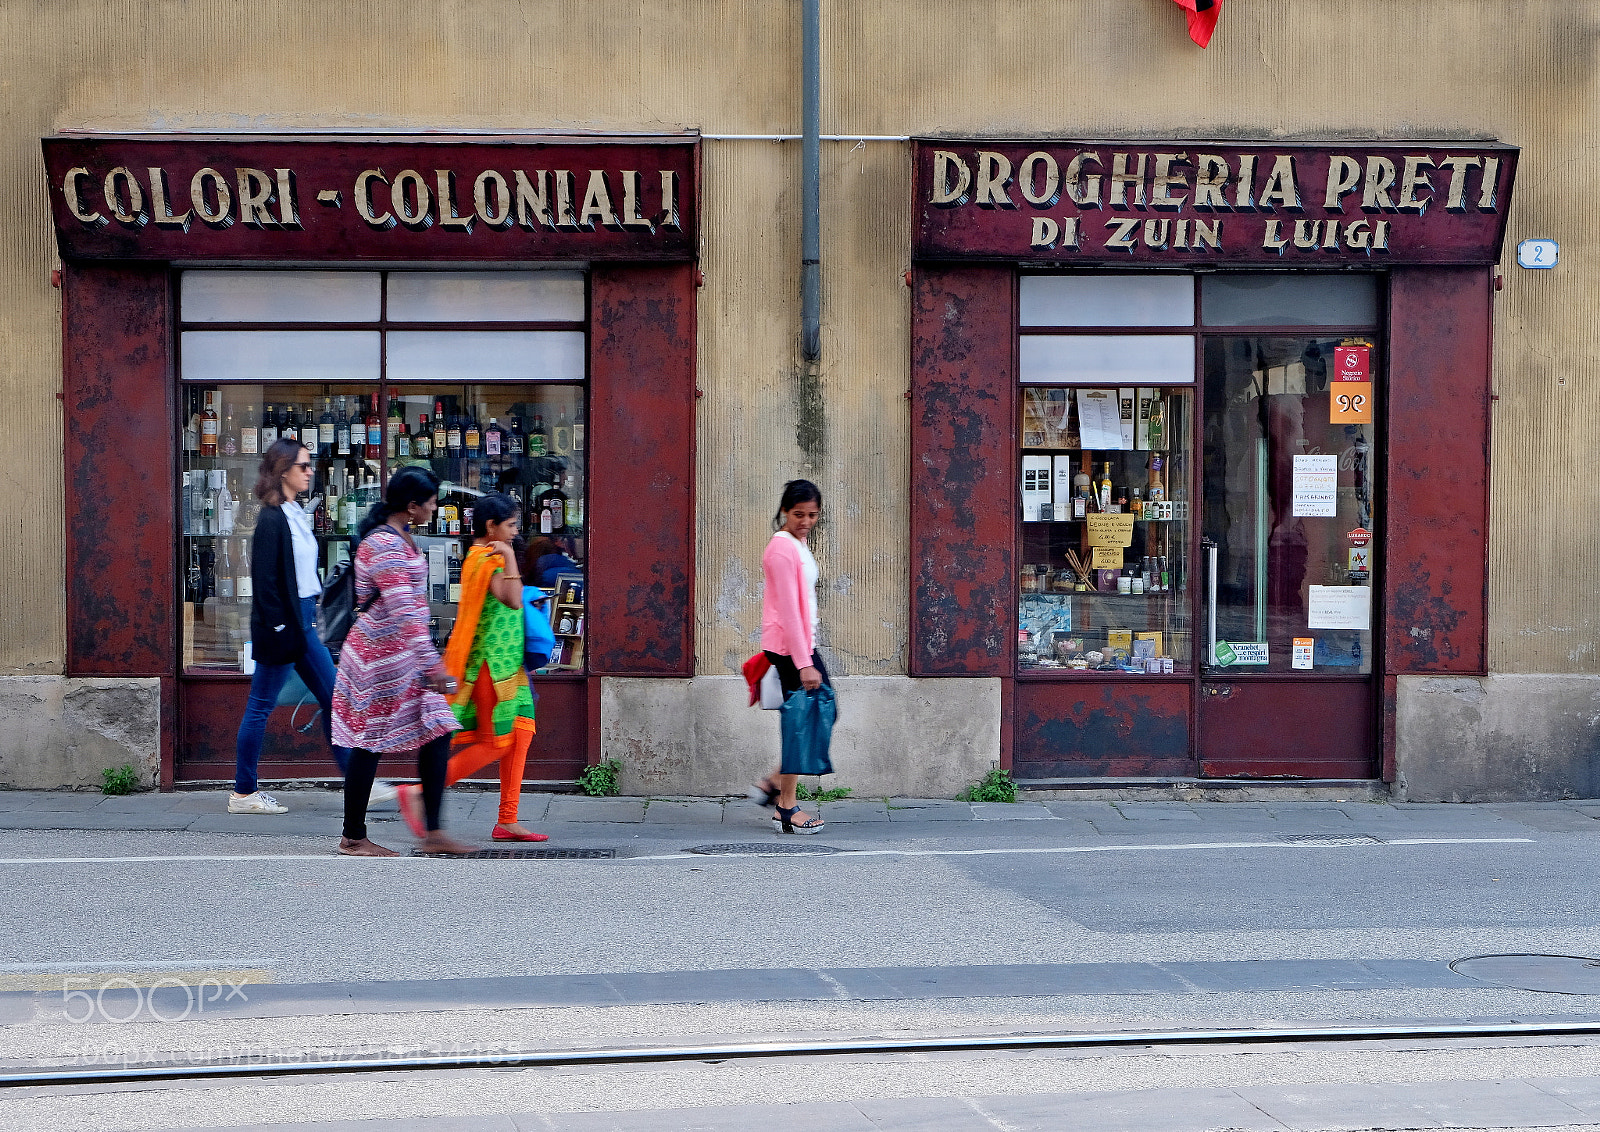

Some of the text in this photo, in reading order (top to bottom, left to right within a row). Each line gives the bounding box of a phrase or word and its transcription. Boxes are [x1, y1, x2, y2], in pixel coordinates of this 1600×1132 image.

[931, 149, 1504, 214] DROGHERIA PRETI
[63, 166, 301, 231] COLORI
[354, 167, 682, 232] COLONIALI
[1030, 215, 1392, 254] DI ZUIN LUIGI
[1532, 245, 1545, 263] 2
[1232, 643, 1260, 651] Kranebet
[1248, 649, 1266, 657] respiri
